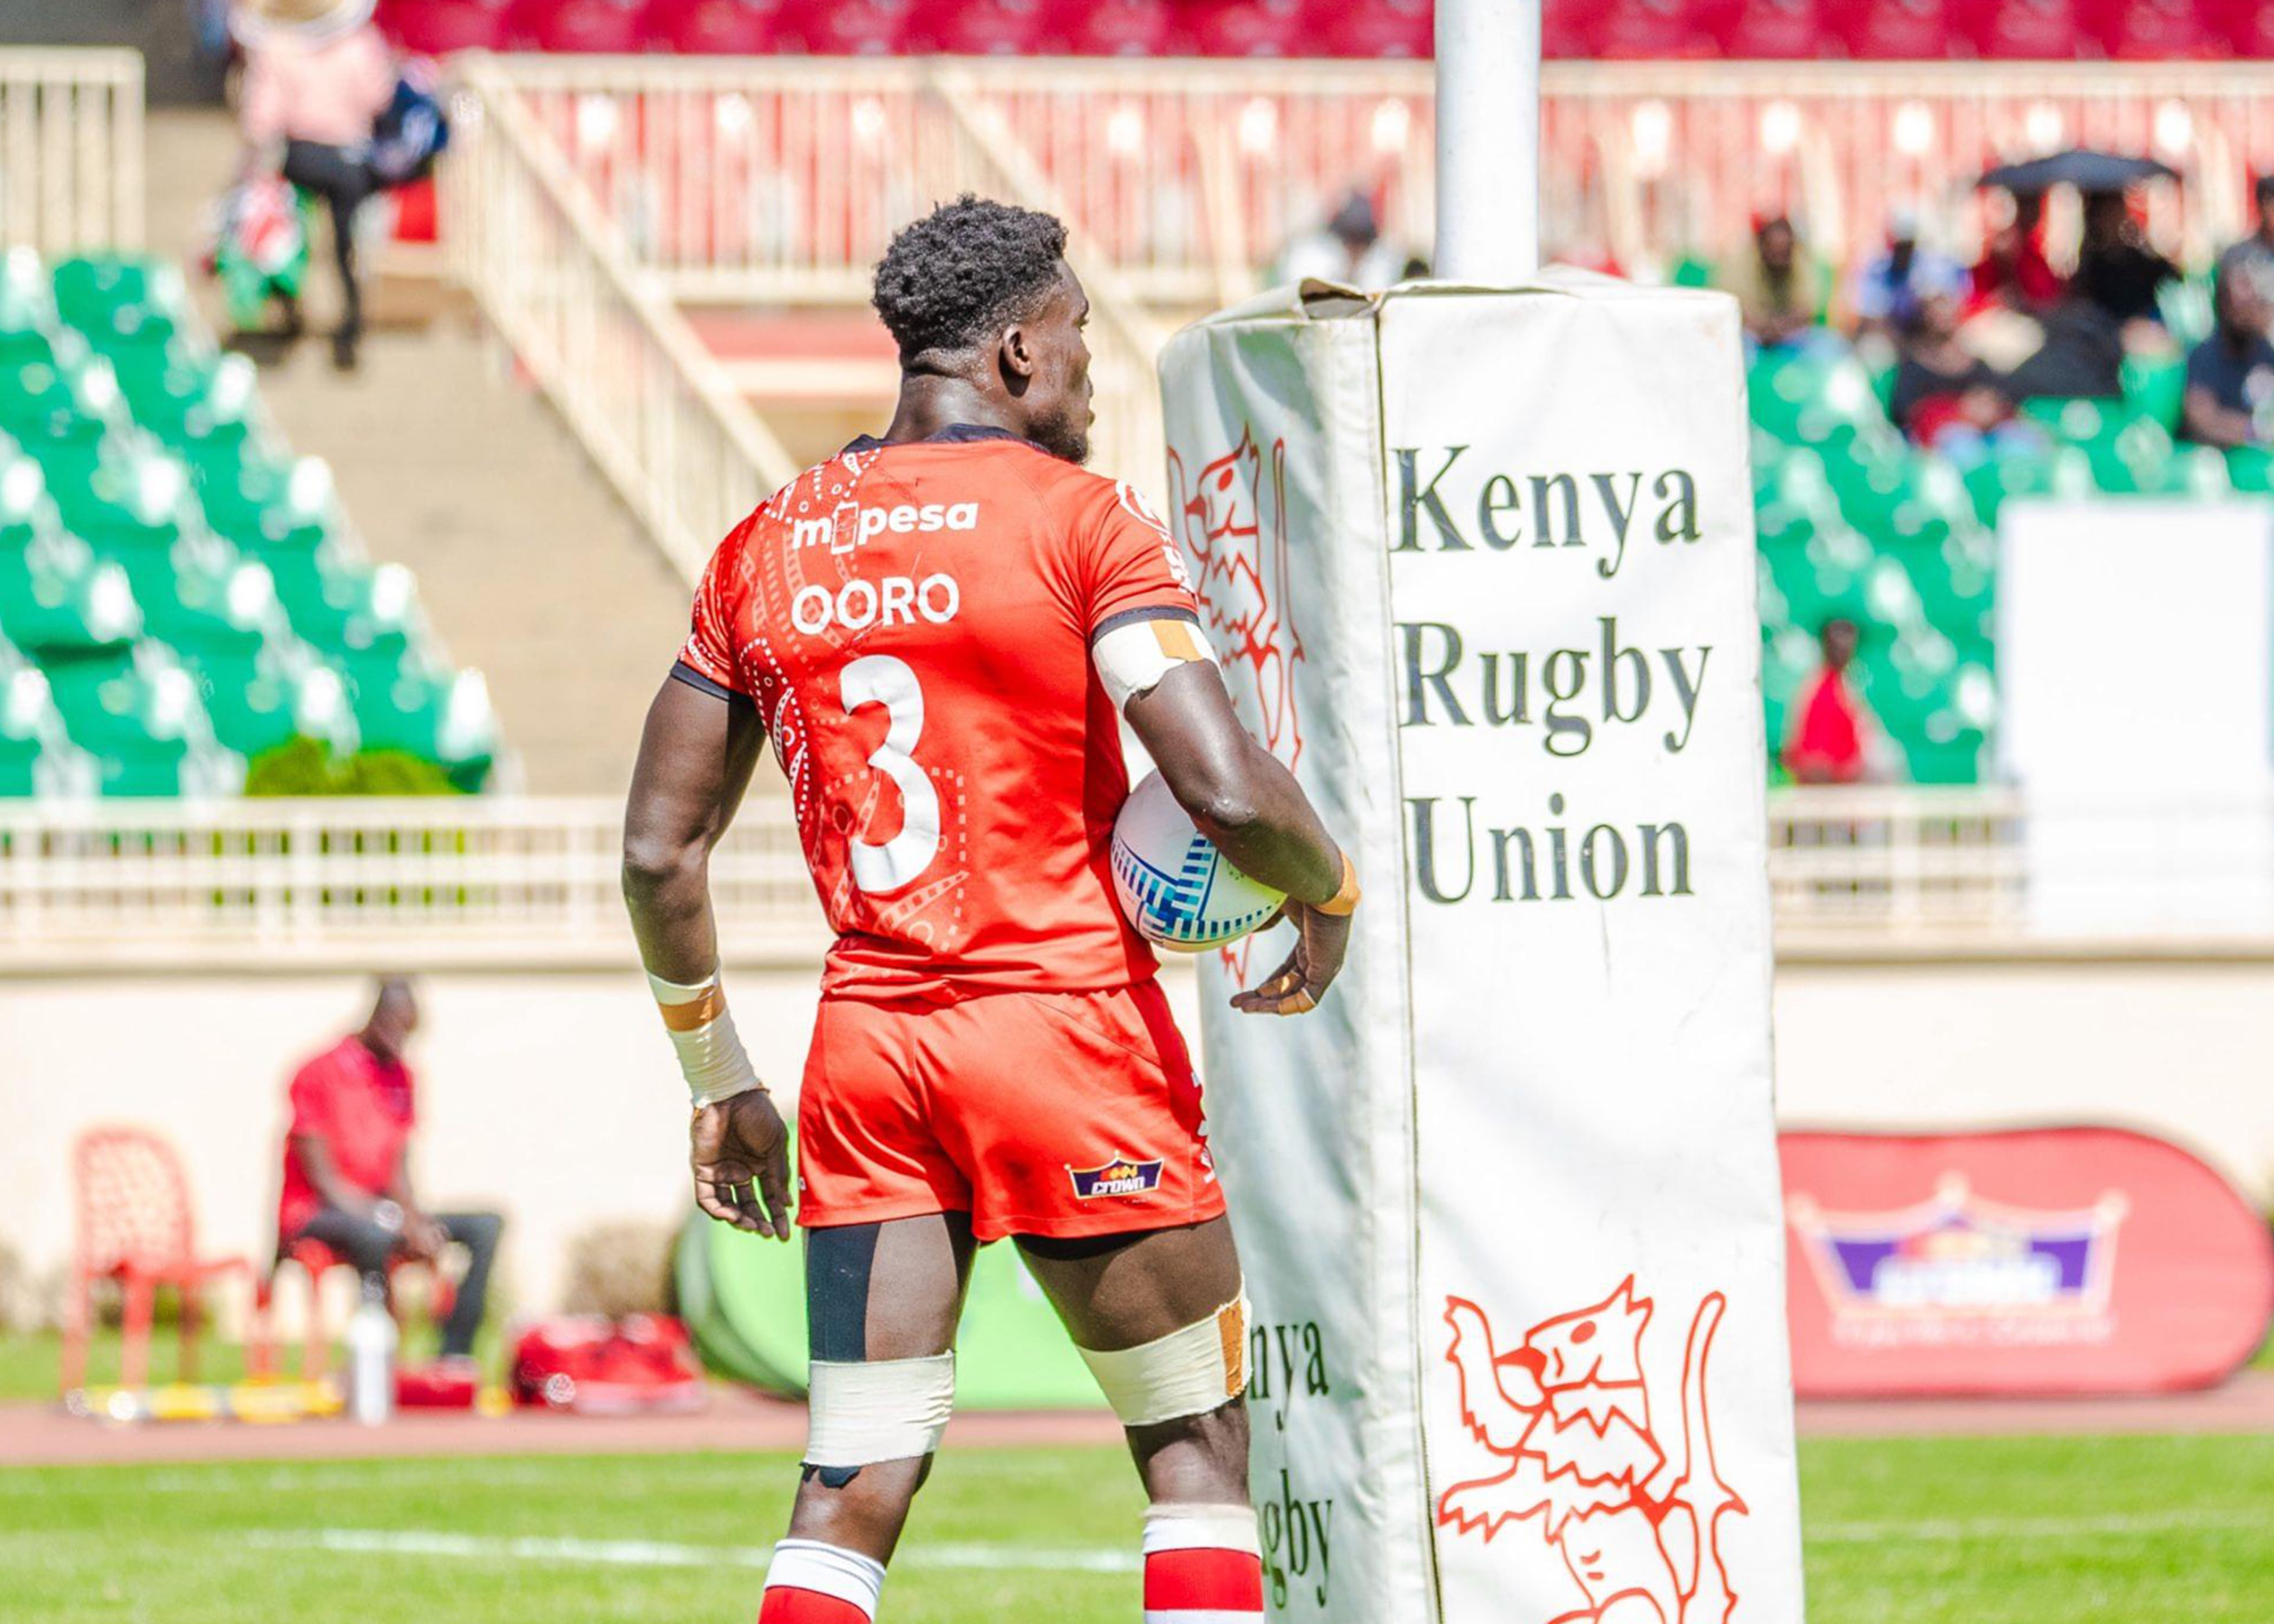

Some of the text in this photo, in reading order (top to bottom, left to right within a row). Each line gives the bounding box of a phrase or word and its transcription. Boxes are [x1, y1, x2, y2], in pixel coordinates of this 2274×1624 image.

[1388, 444, 1702, 580] Kenya
[792, 573, 959, 635] OORO
[1393, 615, 1714, 757] Rugby
[840, 654, 940, 892] 3
[1403, 792, 1695, 905] Union
[1250, 1321, 1329, 1431] nya
[1262, 1468, 1332, 1610] gby
